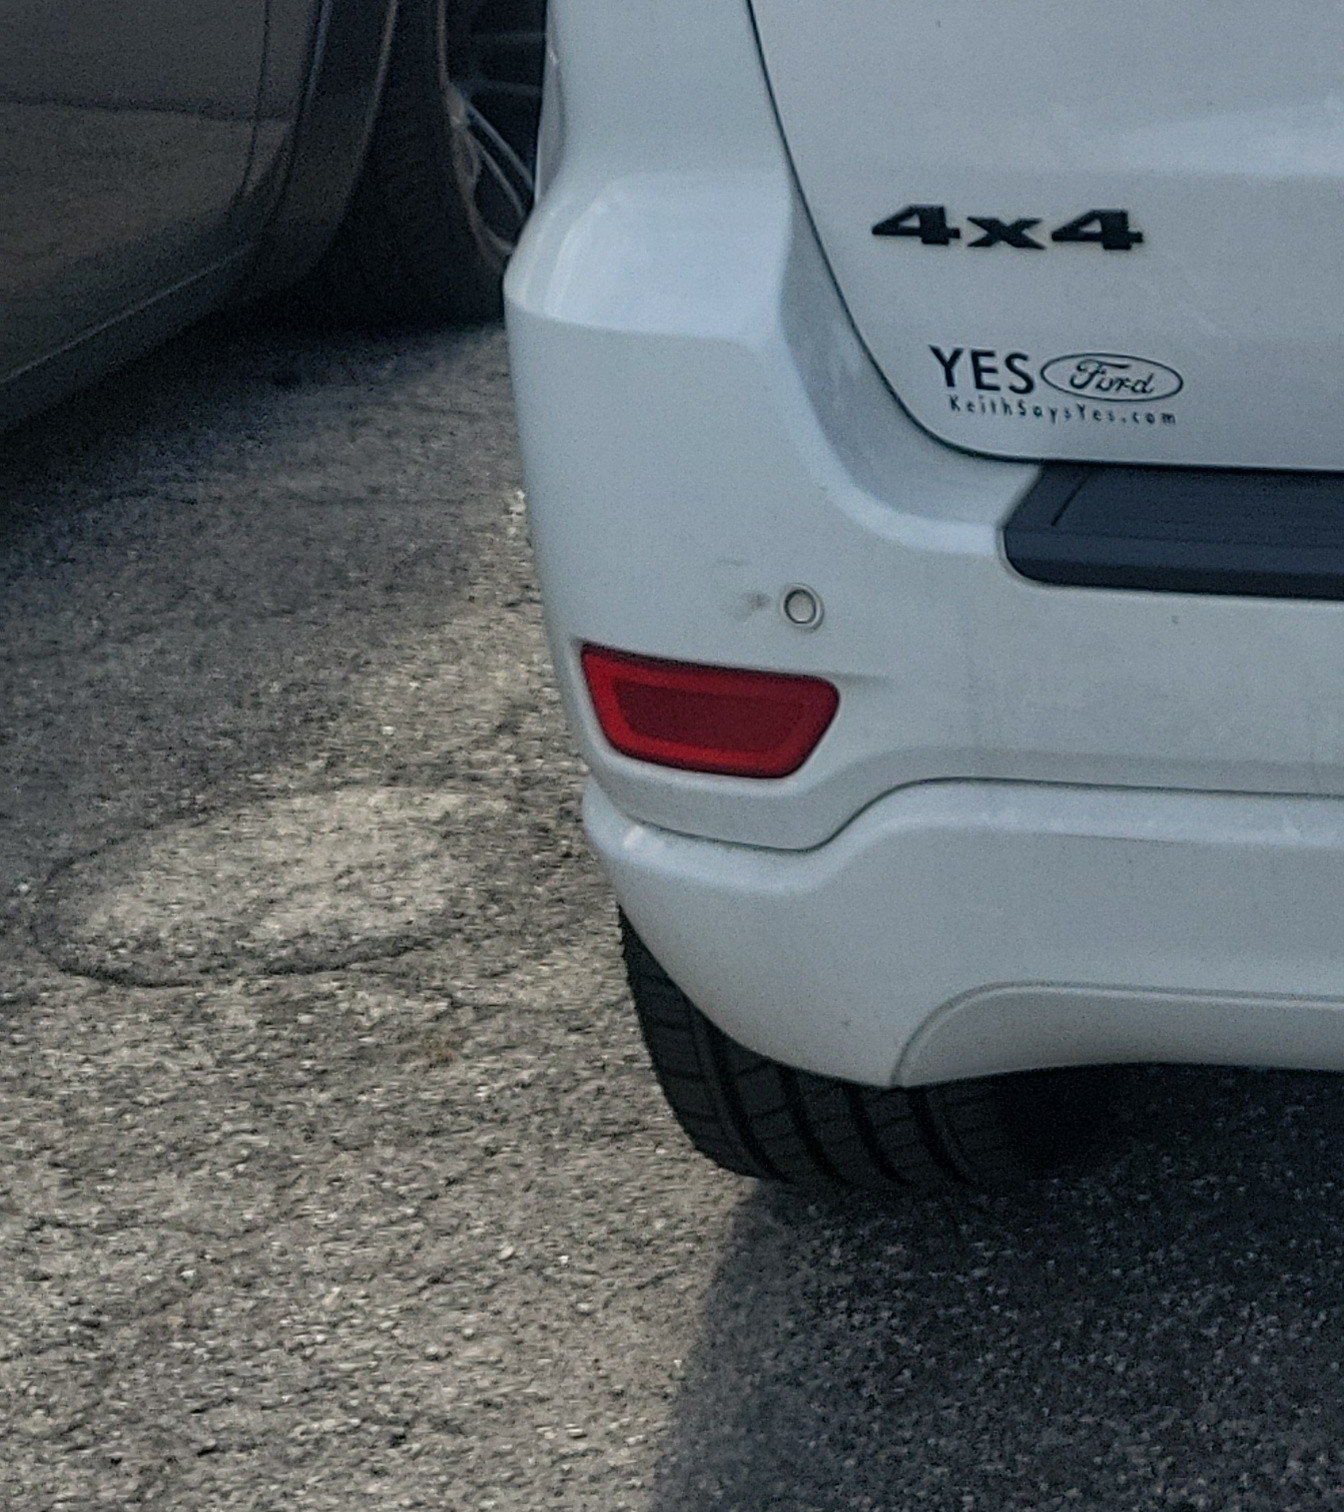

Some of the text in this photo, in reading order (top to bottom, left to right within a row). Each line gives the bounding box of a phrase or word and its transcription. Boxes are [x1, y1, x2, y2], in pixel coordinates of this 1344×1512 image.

[871, 204, 1143, 251] 4x4
[929, 344, 1155, 394] YES Ford
[950, 394, 1177, 425] KeithSaysYes.com
